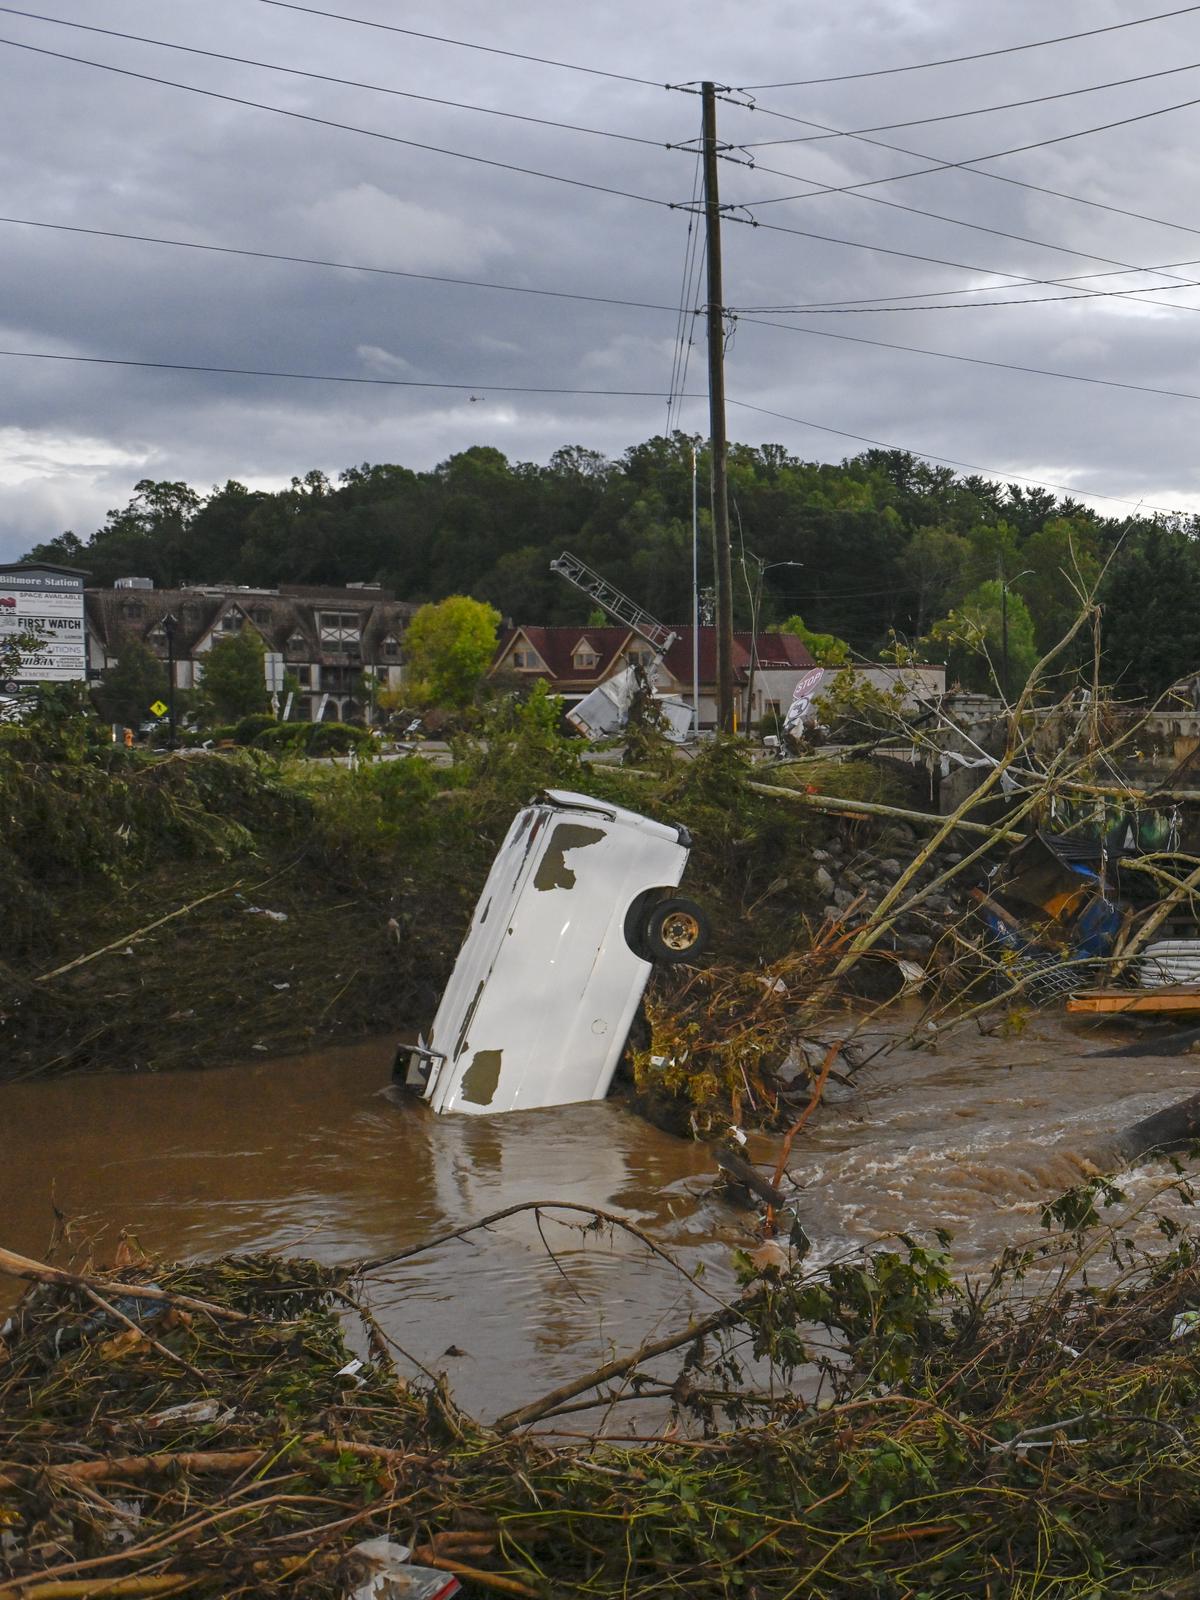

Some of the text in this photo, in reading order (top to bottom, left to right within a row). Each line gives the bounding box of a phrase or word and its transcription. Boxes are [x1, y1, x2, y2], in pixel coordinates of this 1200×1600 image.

[0, 575, 79, 587] Biltmore Station
[18, 617, 81, 630] FIRST WATCH
[796, 672, 821, 693] STOP
